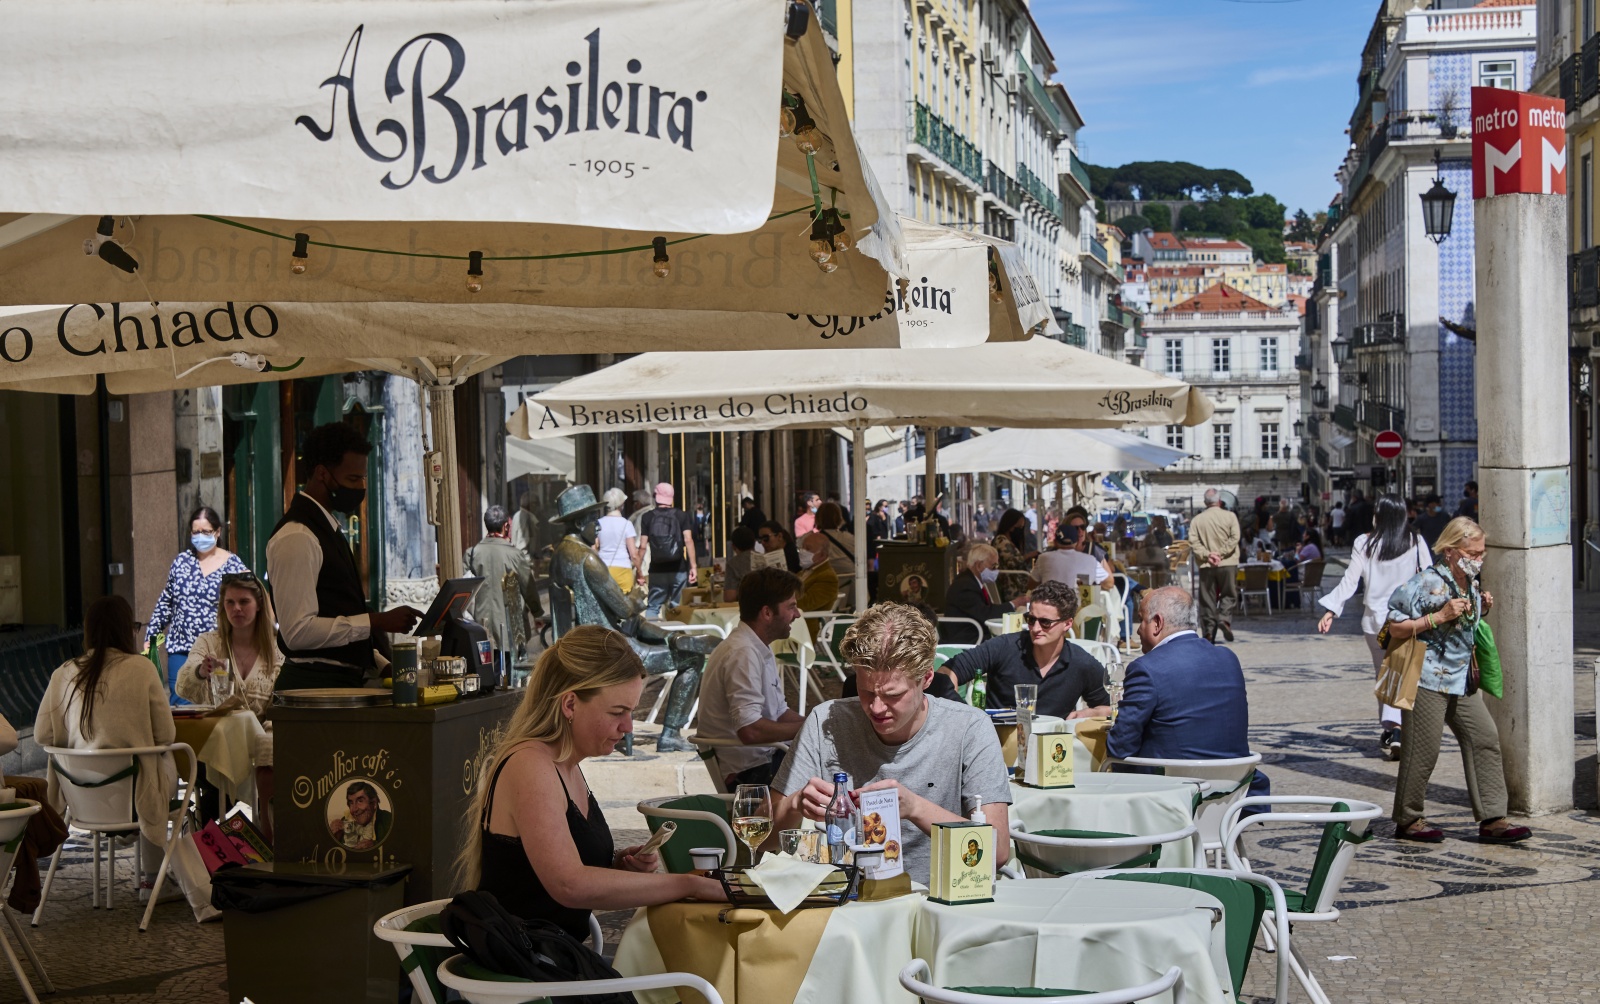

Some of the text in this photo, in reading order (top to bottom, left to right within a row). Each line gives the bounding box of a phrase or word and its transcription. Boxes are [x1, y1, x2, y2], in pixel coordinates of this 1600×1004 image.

[295, 23, 697, 190] A Brasileira
[1475, 107, 1518, 134] metro
[1528, 106, 1565, 129] metro
[584, 159, 635, 178] 1905
[57, 302, 279, 357] Chiado
[538, 391, 868, 430] A Brasileira do Chiado
[1097, 390, 1173, 415] A Brasileira
[291, 775, 314, 809] O
[317, 750, 358, 800] melhor
[362, 749, 390, 777] café
